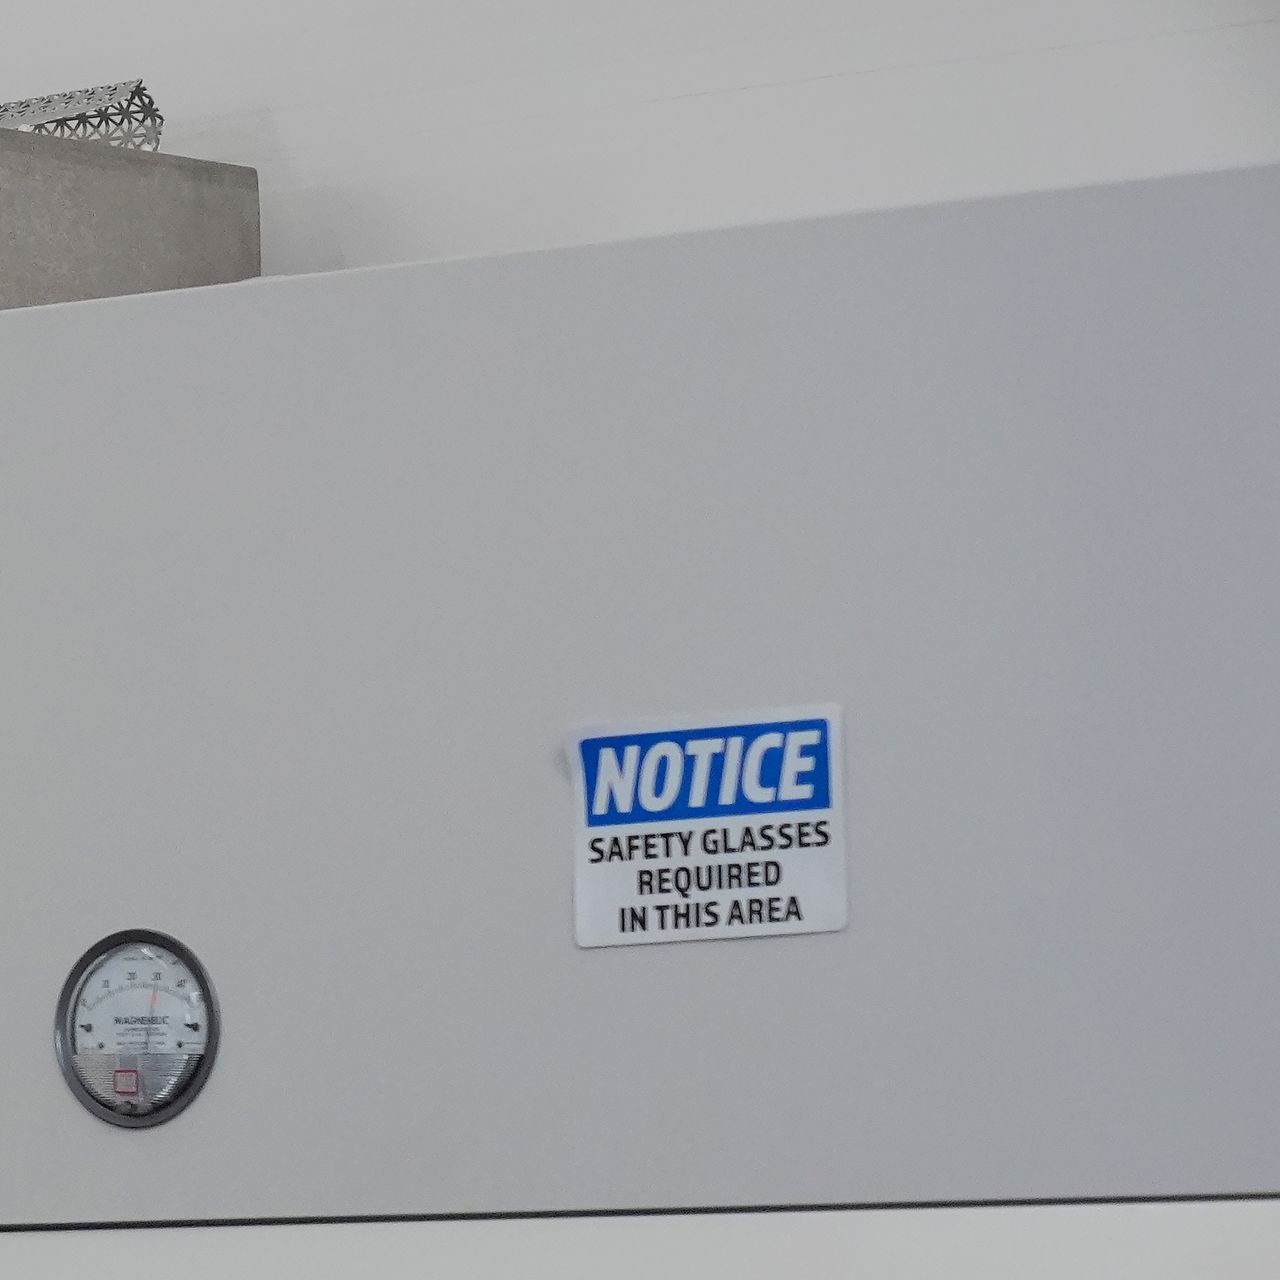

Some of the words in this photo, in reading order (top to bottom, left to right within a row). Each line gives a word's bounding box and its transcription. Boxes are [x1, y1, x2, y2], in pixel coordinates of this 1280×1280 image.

[592, 728, 822, 816] NOTICE
[589, 830, 694, 864] SAFETY
[700, 820, 830, 856] GLASSES
[638, 860, 781, 898] REQUIRED
[619, 906, 648, 933] IN
[655, 900, 719, 930] THIS
[727, 896, 804, 927] AREA
